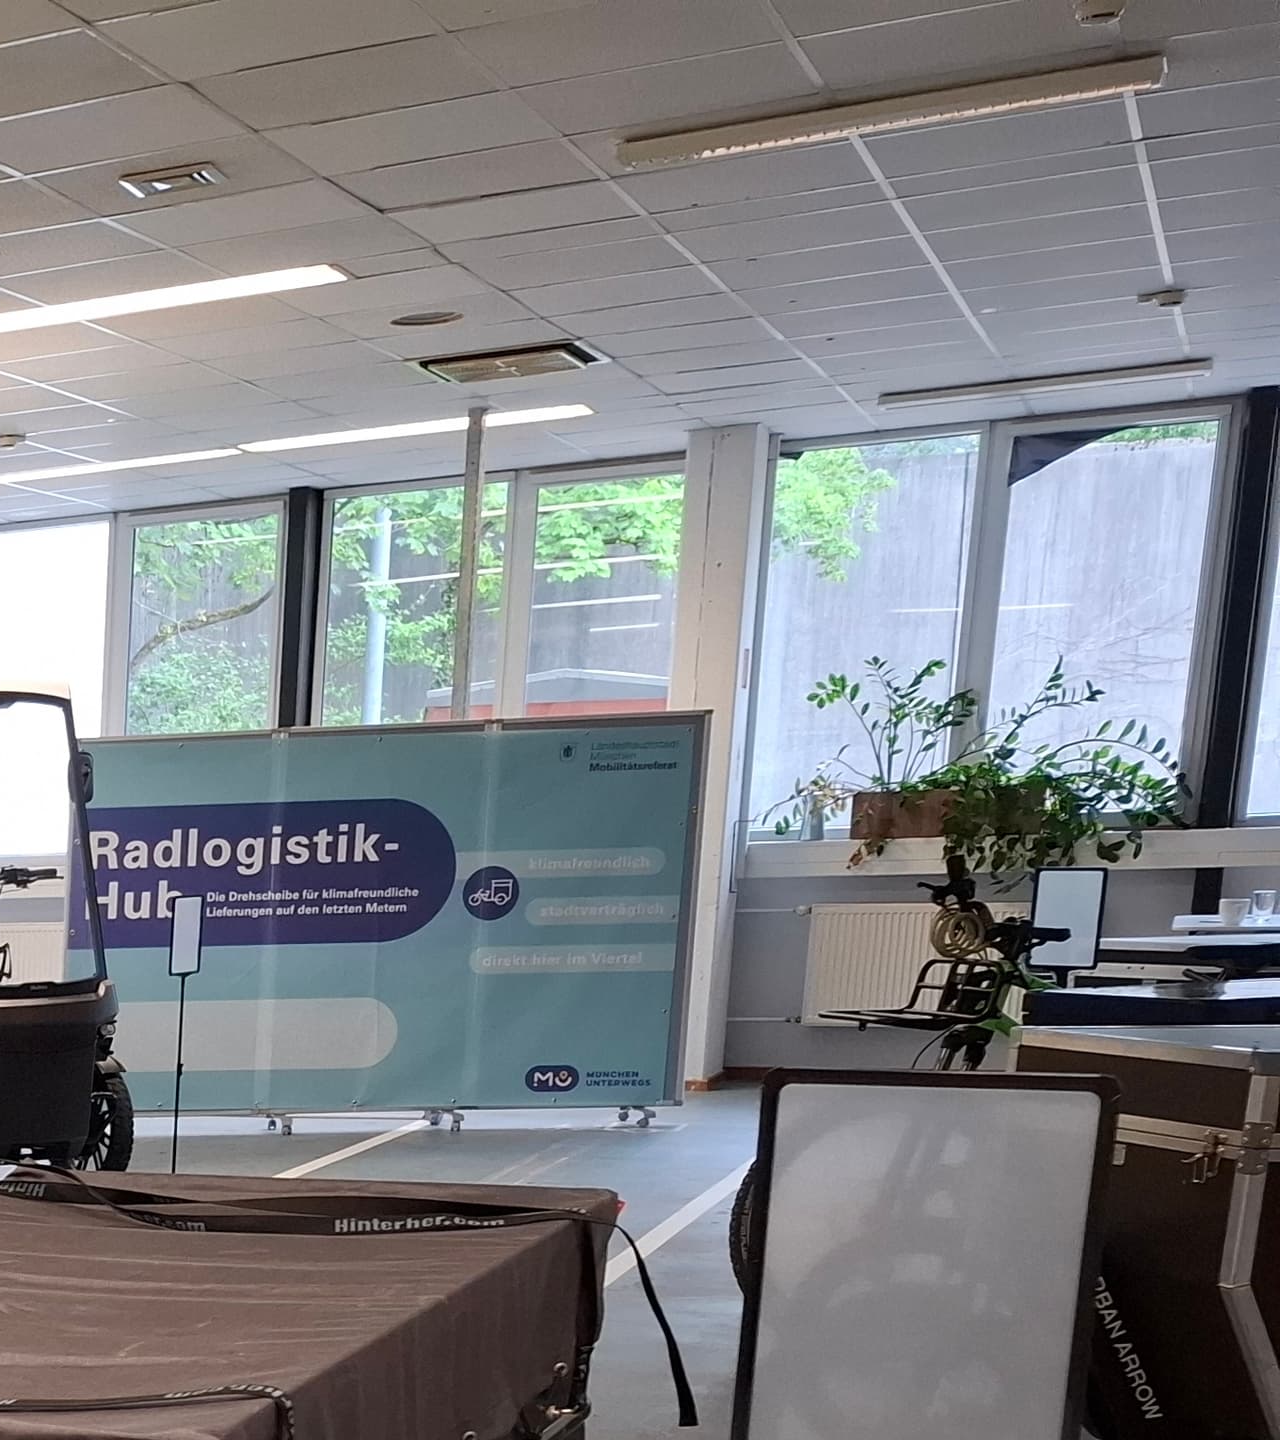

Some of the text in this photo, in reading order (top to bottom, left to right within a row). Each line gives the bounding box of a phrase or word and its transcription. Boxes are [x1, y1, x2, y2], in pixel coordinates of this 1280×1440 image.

[589, 761, 677, 772] Mobilitätsreferat
[89, 823, 400, 875] Radlogistik-
[206, 887, 419, 902] Die Drehscheibe für klimafreundliche
[206, 902, 407, 918] Lieferungen auf den letzten Metern
[482, 952, 643, 967] direkt hier im Viertel
[585, 1079, 652, 1087] UNTERWEGS
[335, 1214, 505, 1234] Hinterher.com
[1112, 1343, 1164, 1419] ARROW
